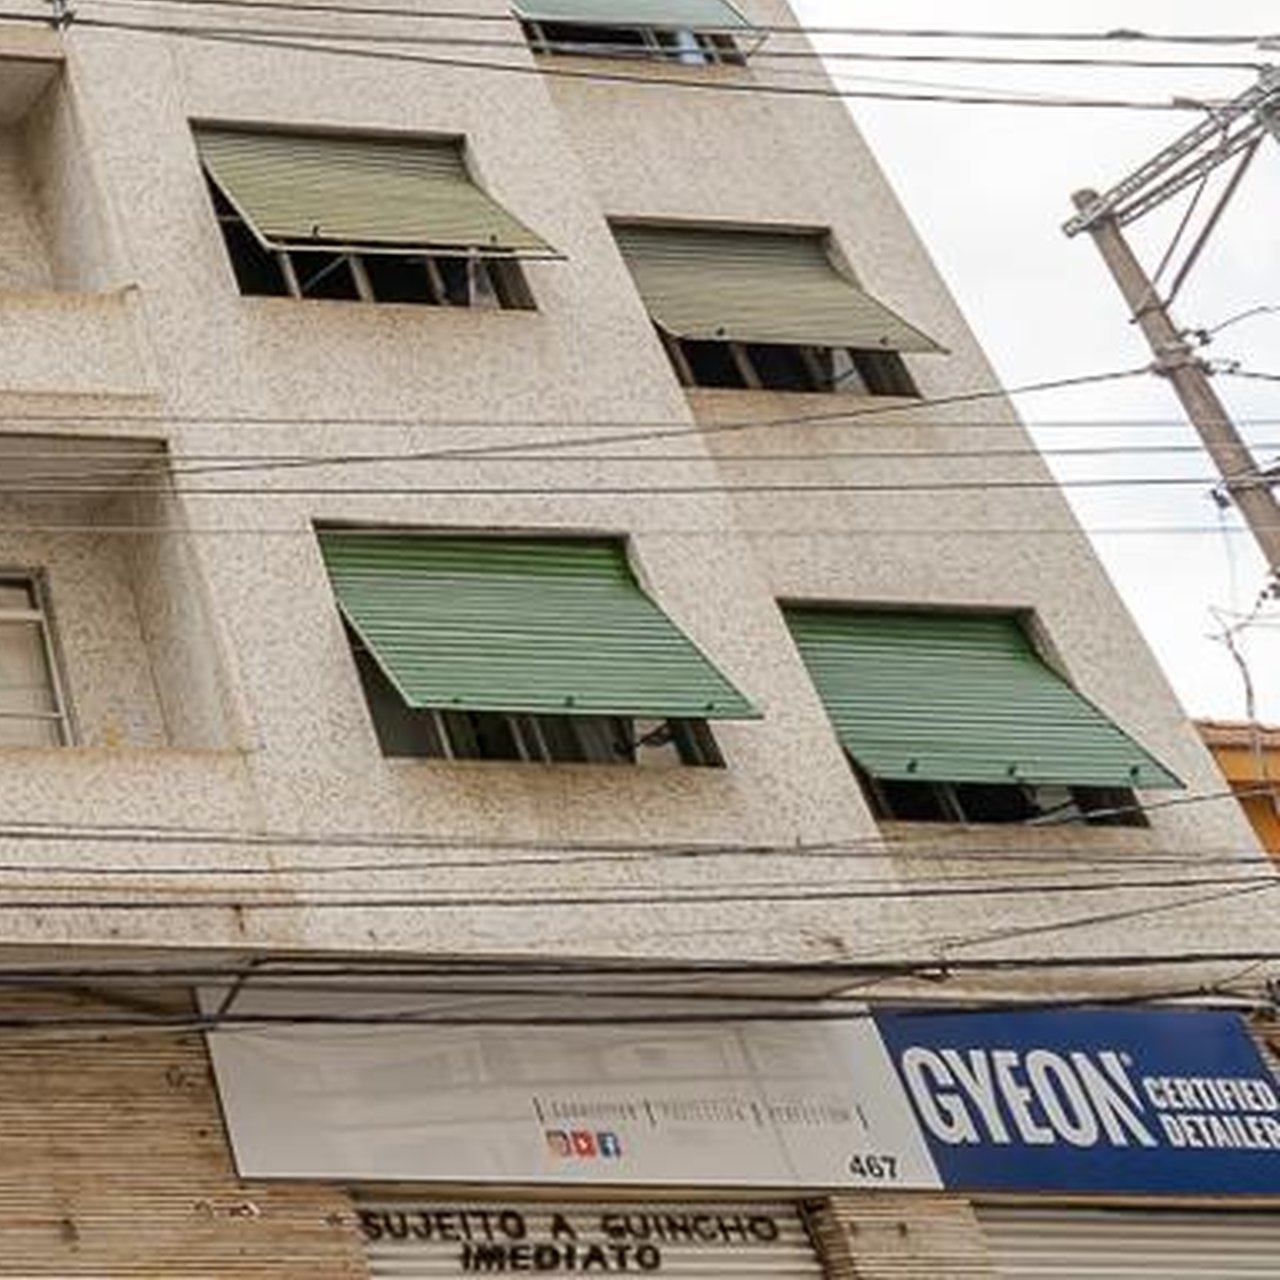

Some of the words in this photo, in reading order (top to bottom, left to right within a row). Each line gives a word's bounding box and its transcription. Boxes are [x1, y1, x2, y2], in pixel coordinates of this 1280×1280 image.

[901, 1046, 1158, 1148] GYEON
[1143, 1076, 1278, 1112] CERTIFIED
[849, 1154, 898, 1182] 467
[362, 1210, 525, 1241] SUJEITO
[552, 1214, 578, 1241] A
[601, 1214, 780, 1243] GUINCHO
[461, 1244, 662, 1272] IMEDIATO
